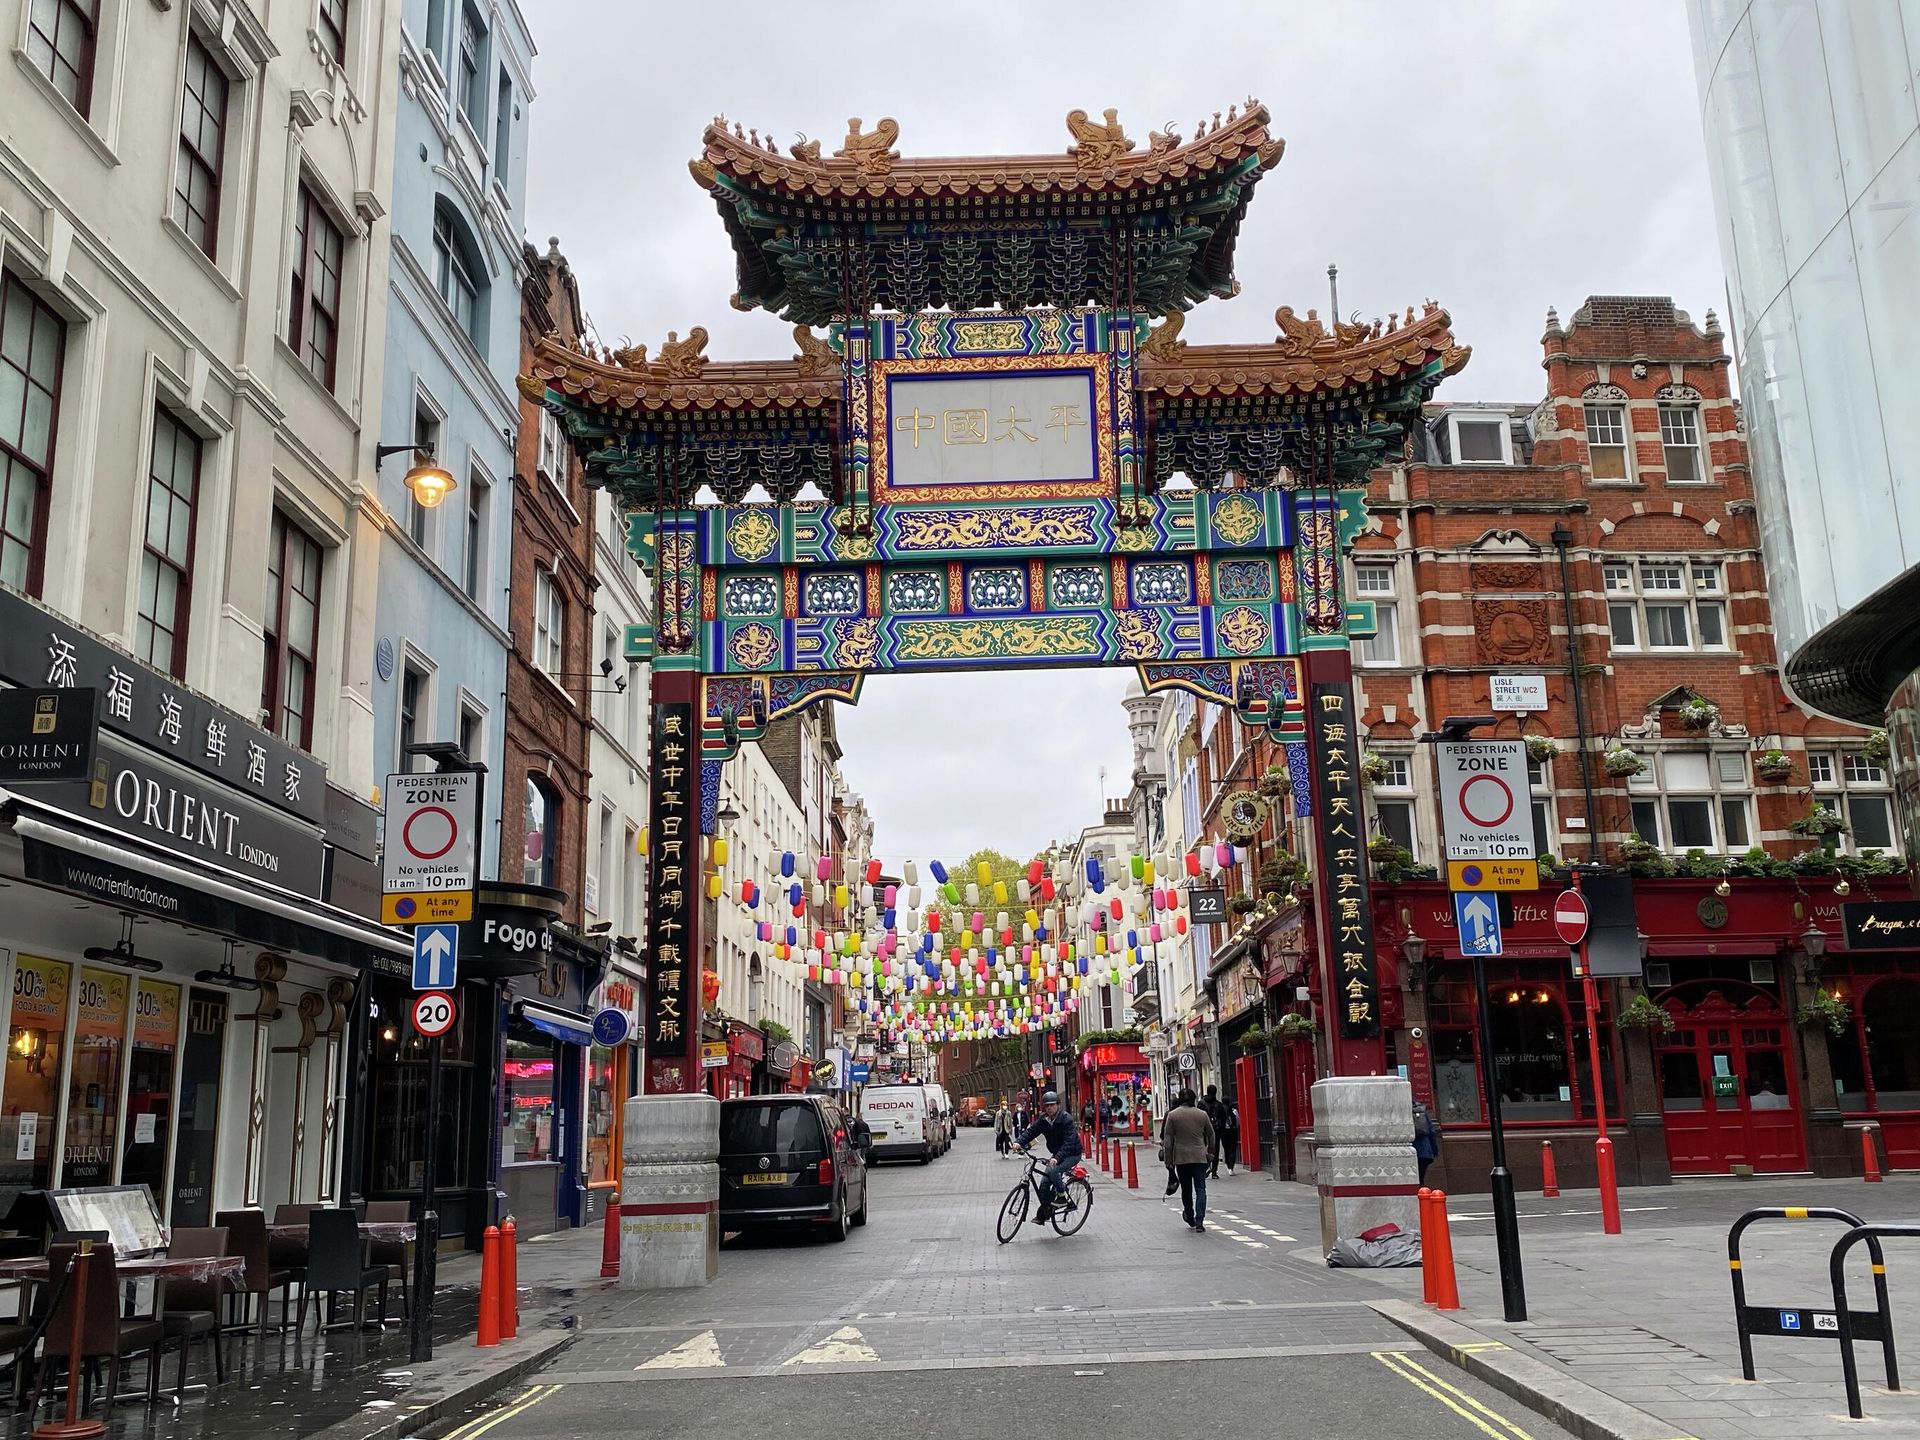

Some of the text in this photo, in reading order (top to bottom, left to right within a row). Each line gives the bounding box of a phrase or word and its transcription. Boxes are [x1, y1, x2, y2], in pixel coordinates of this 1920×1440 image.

[896, 405, 1087, 449] 中國太平
[1495, 686, 1521, 694] STREET
[0, 743, 84, 758] ORIENT
[1446, 745, 1518, 755] PEDESTRIAN
[19, 761, 61, 770] LONDON
[1457, 757, 1509, 771] ZONE
[396, 776, 468, 788] PEDESTRIAN
[405, 789, 457, 804] ZONE
[114, 769, 279, 873] ORIENT LONDON
[1460, 832, 1520, 842] No vehicles
[1489, 844, 1504, 856] 10
[1508, 847, 1529, 858] pm
[398, 864, 459, 875] No vehicles
[1492, 866, 1526, 877] At any
[425, 876, 442, 888] 10
[445, 877, 467, 889] pm
[1498, 876, 1521, 886] time
[68, 866, 178, 912] www.orientlondon.com
[427, 898, 460, 909] At any
[1198, 898, 1217, 911] 22
[431, 907, 455, 917] time
[1513, 906, 1548, 922] ittle
[484, 919, 537, 953] Fogo
[15, 1000, 33, 1012] FOOD
[38, 1004, 59, 1015] DRINKS
[419, 1003, 450, 1024] 20
[868, 1101, 914, 1111] REDDAN
[63, 1145, 112, 1164] ORIENT
[73, 1166, 98, 1177] LONDON
[747, 1174, 764, 1183] RX16
[179, 1187, 203, 1199] ORIENT
[1784, 1314, 1797, 1327] P
